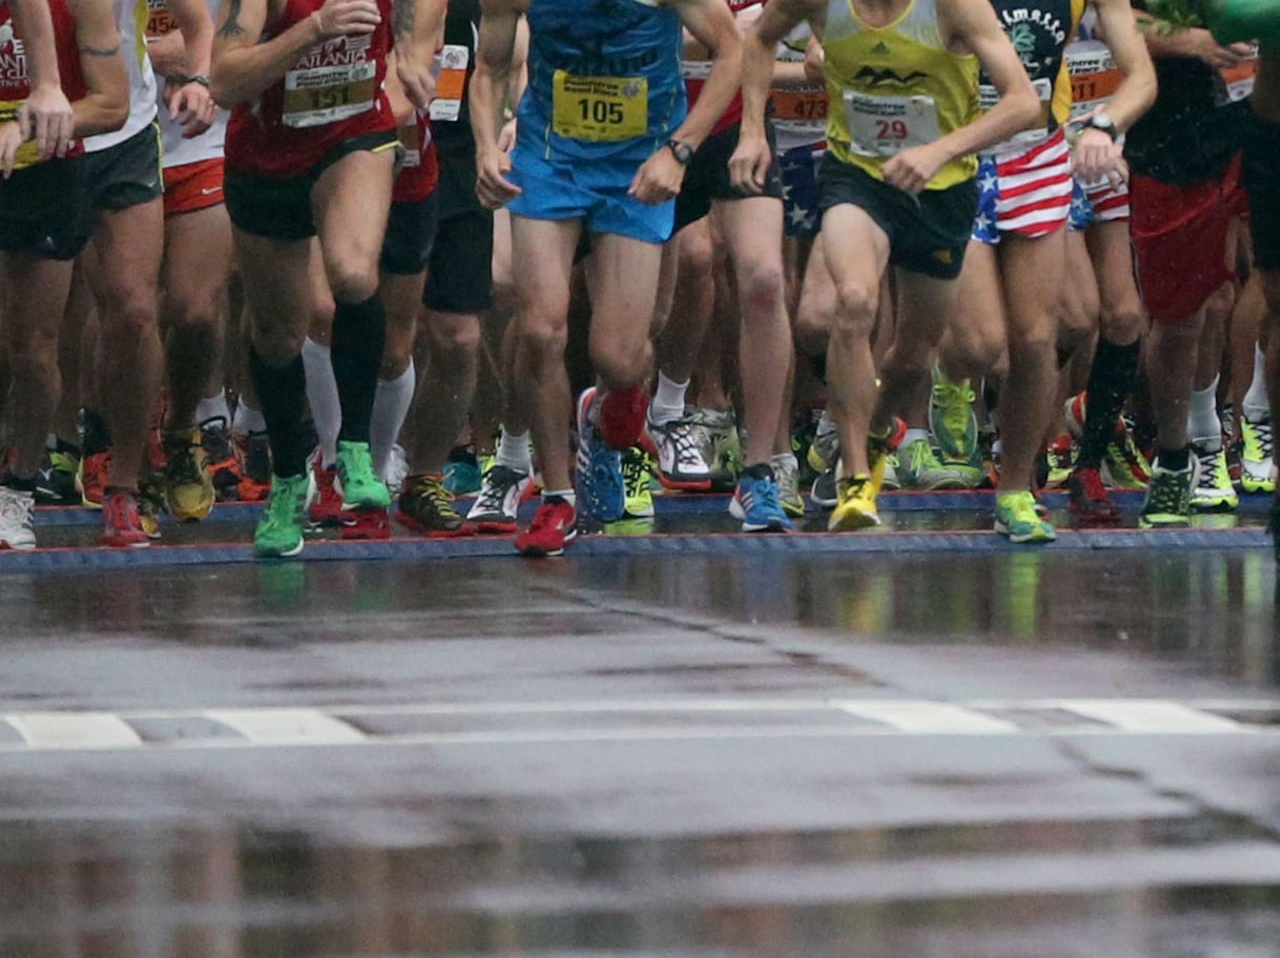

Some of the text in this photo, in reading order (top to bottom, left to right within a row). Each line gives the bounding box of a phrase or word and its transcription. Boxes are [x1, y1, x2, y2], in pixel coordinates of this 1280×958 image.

[577, 98, 624, 124] 105
[793, 99, 828, 118] 473
[875, 119, 908, 140] 29
